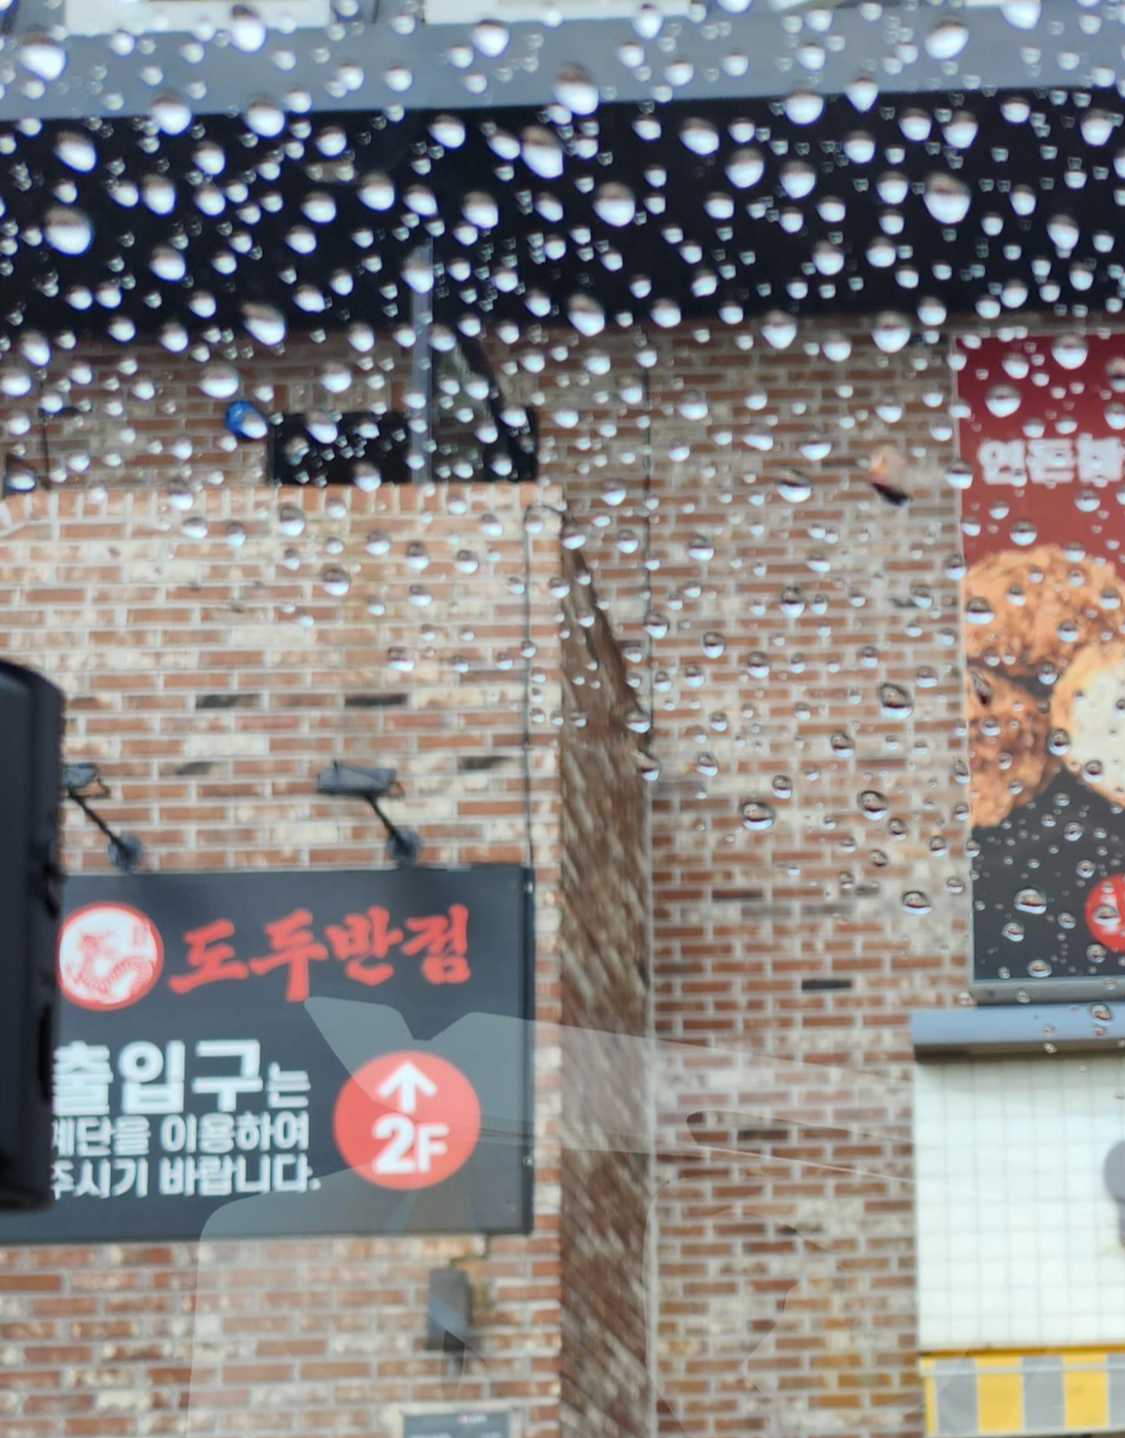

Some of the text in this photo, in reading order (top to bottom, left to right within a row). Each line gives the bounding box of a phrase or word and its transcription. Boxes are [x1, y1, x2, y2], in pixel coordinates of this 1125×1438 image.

[168, 903, 471, 1001] 도두반점
[52, 1038, 311, 1117] 출입구는
[160, 1110, 310, 1154] 이용하여
[371, 1115, 449, 1175] 2F
[159, 1152, 321, 1197] 바랍니다.
